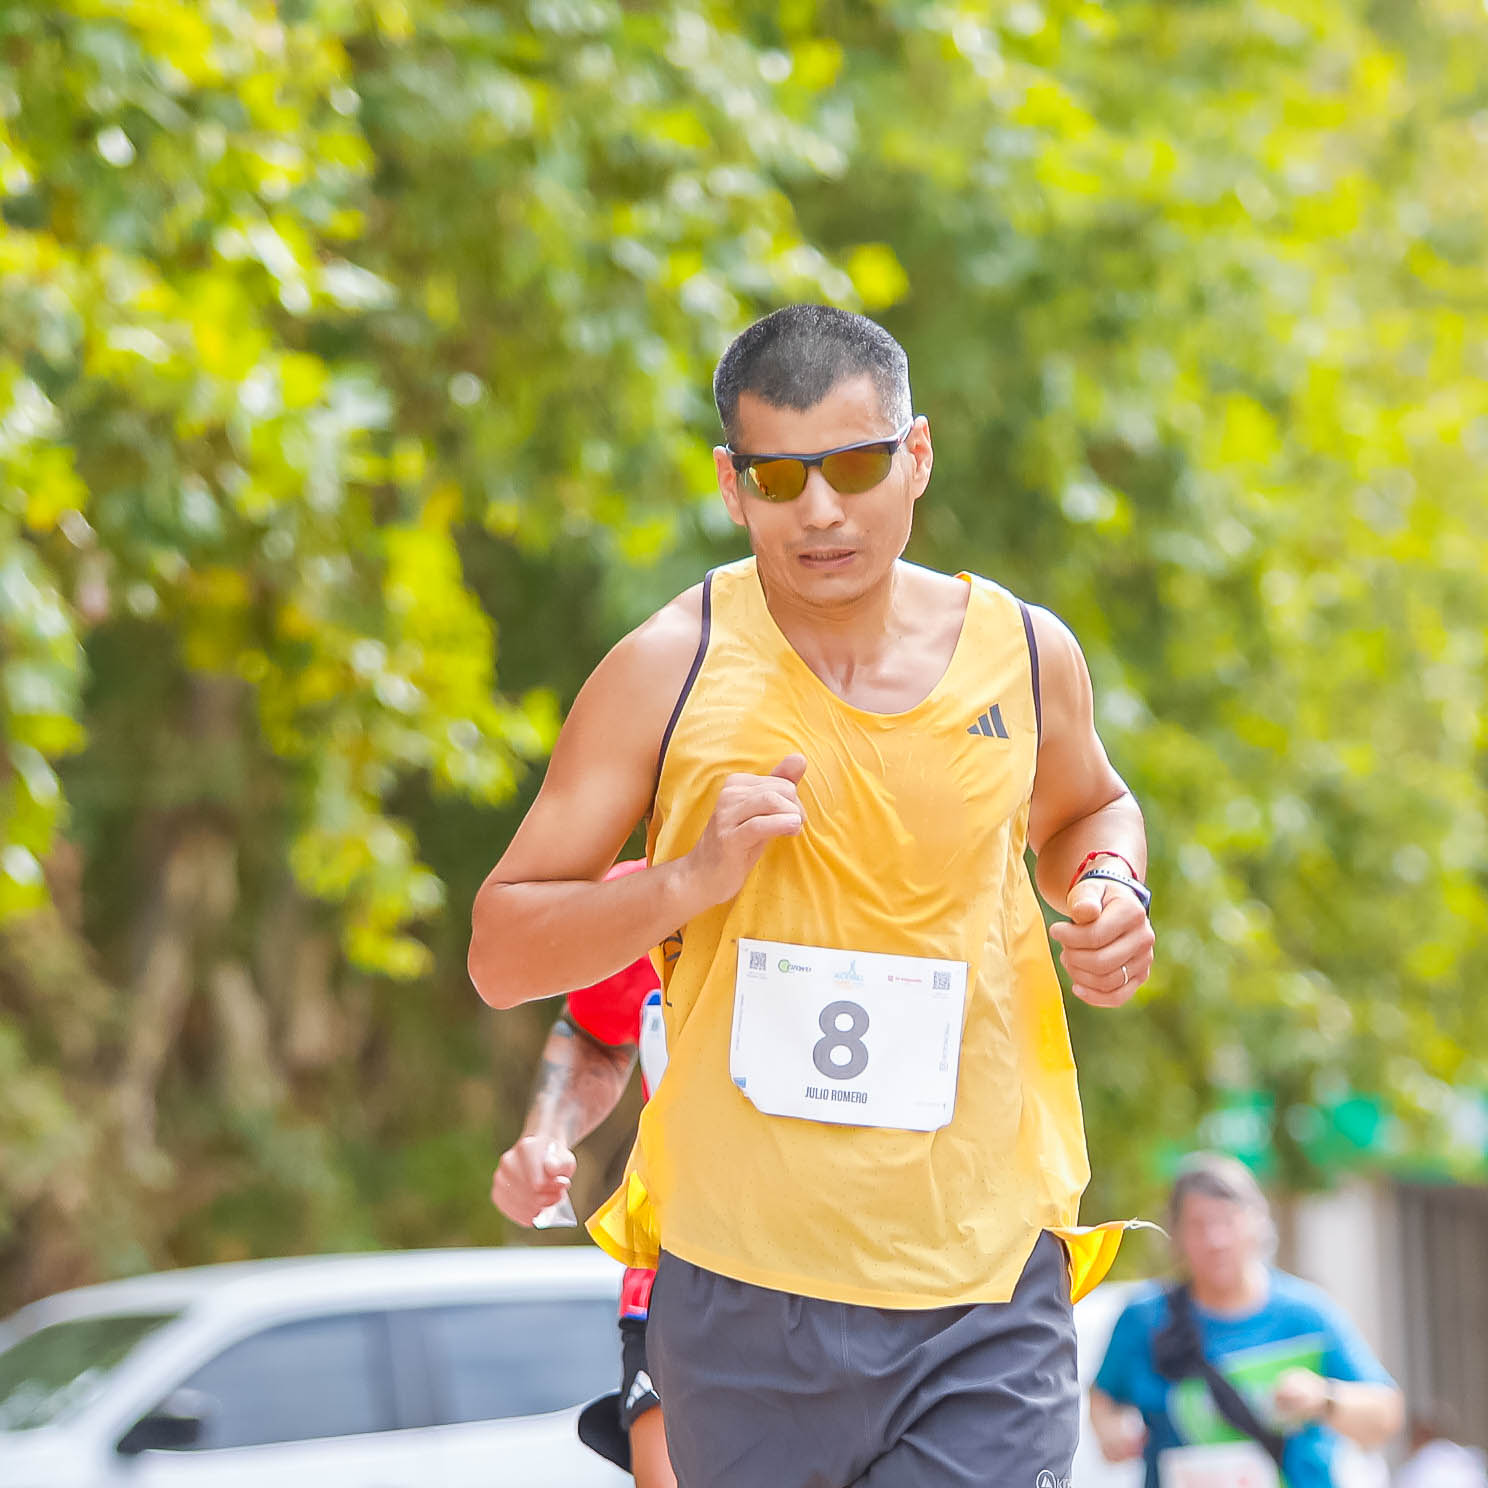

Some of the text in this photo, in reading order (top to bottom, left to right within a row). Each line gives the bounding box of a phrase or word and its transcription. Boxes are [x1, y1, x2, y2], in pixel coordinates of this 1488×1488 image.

[812, 1000, 870, 1080] 8
[805, 1086, 868, 1105] JULIO ROMERO
